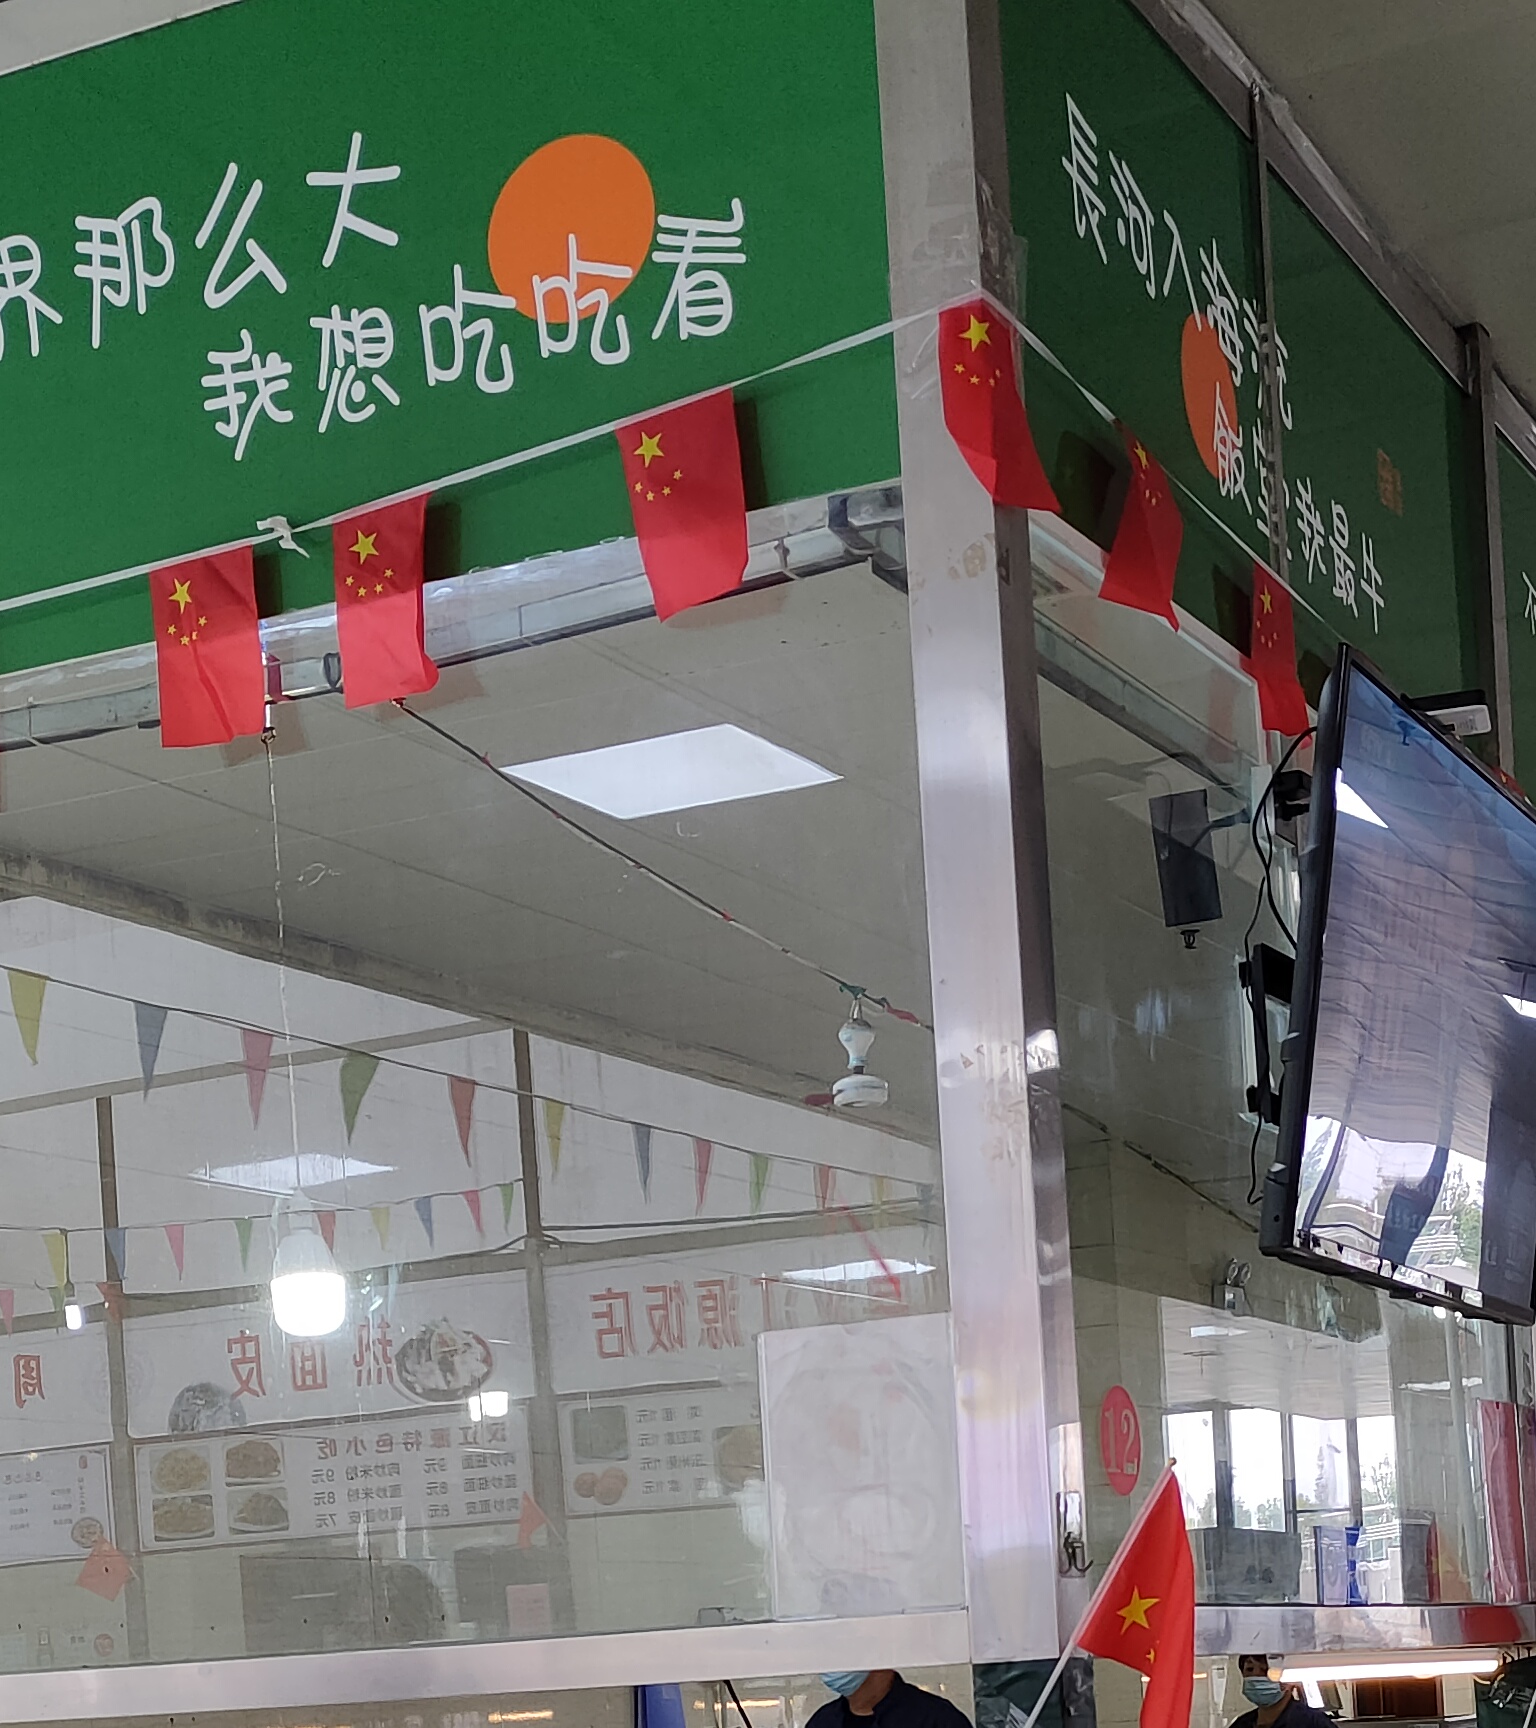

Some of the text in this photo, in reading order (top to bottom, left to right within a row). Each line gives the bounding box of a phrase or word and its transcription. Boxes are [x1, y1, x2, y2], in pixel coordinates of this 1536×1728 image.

[200, 197, 747, 461] 我想吃吃看
[1104, 1407, 1138, 1476] 12
